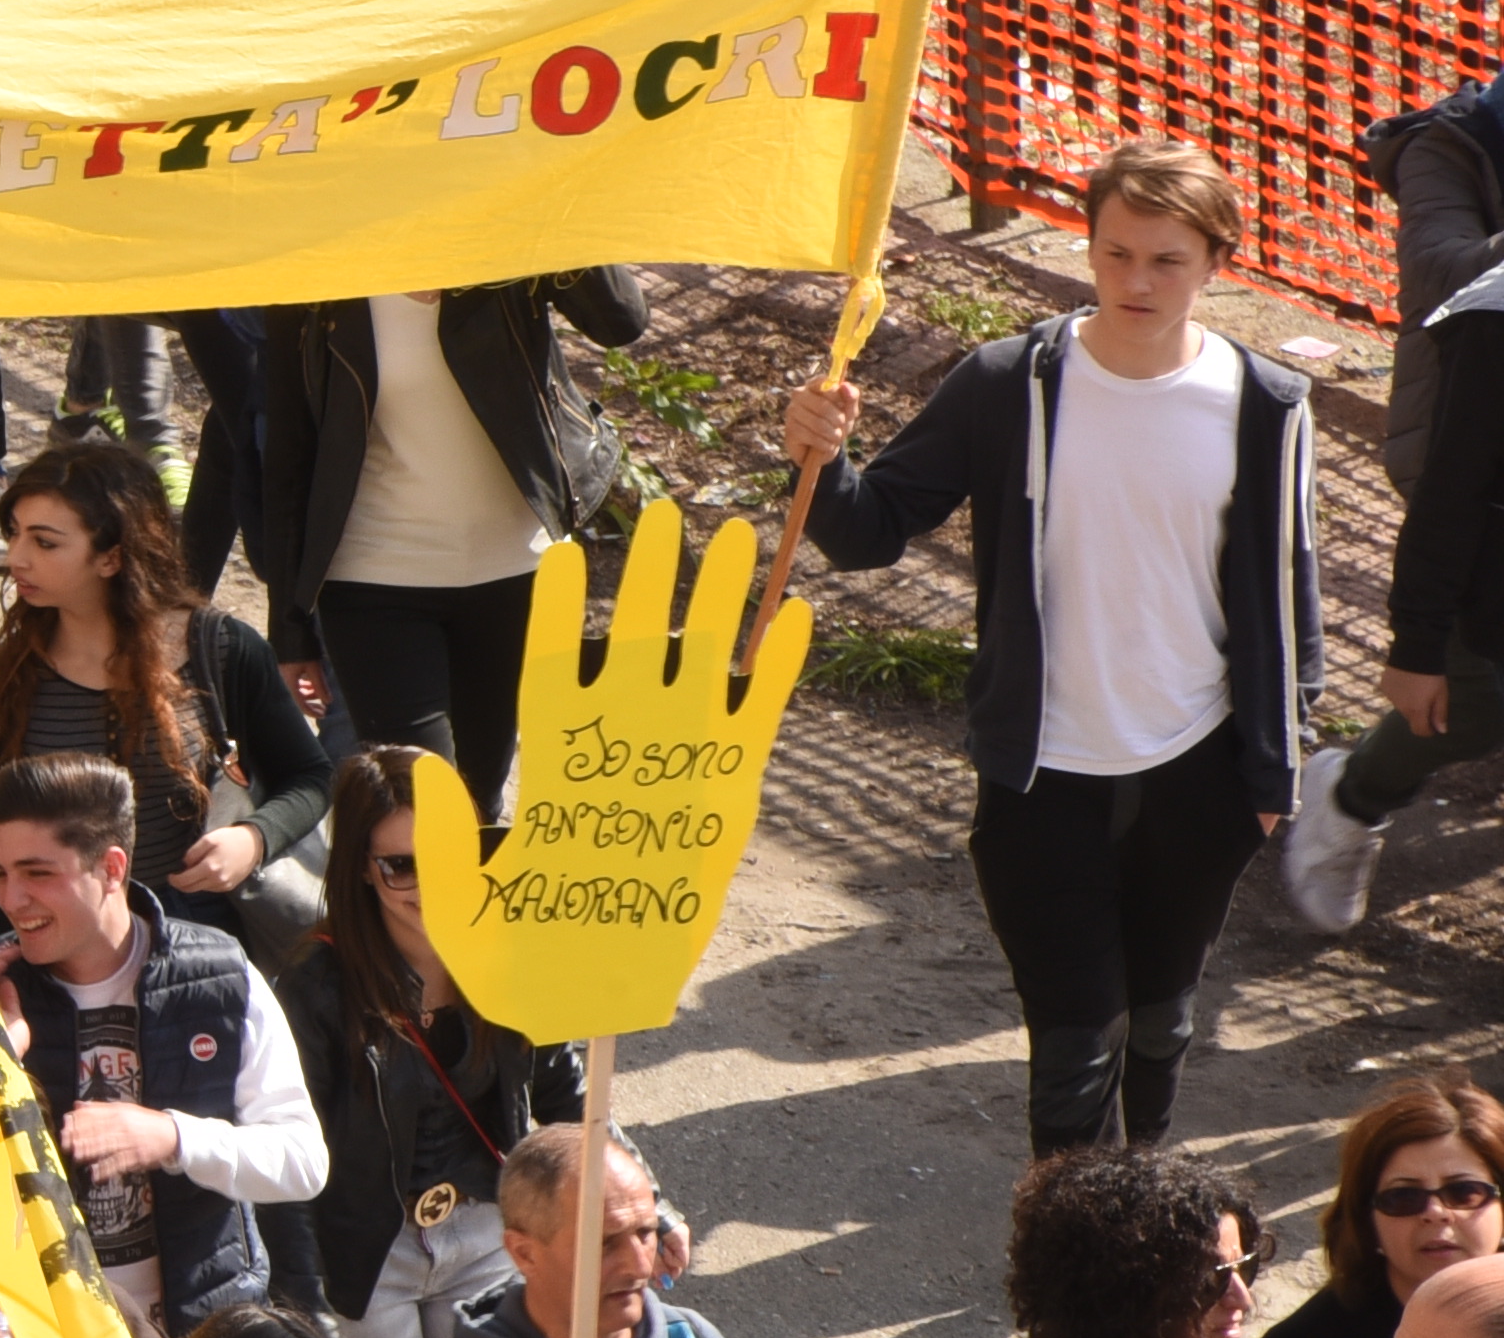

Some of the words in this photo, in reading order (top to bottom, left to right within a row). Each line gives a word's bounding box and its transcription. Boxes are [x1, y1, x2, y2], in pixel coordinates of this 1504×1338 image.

[438, 10, 879, 142] LOCRI
[563, 715, 634, 782] Io
[636, 741, 746, 787] sono
[525, 800, 725, 859] ANTONIO
[470, 868, 704, 928] MAIORANO
